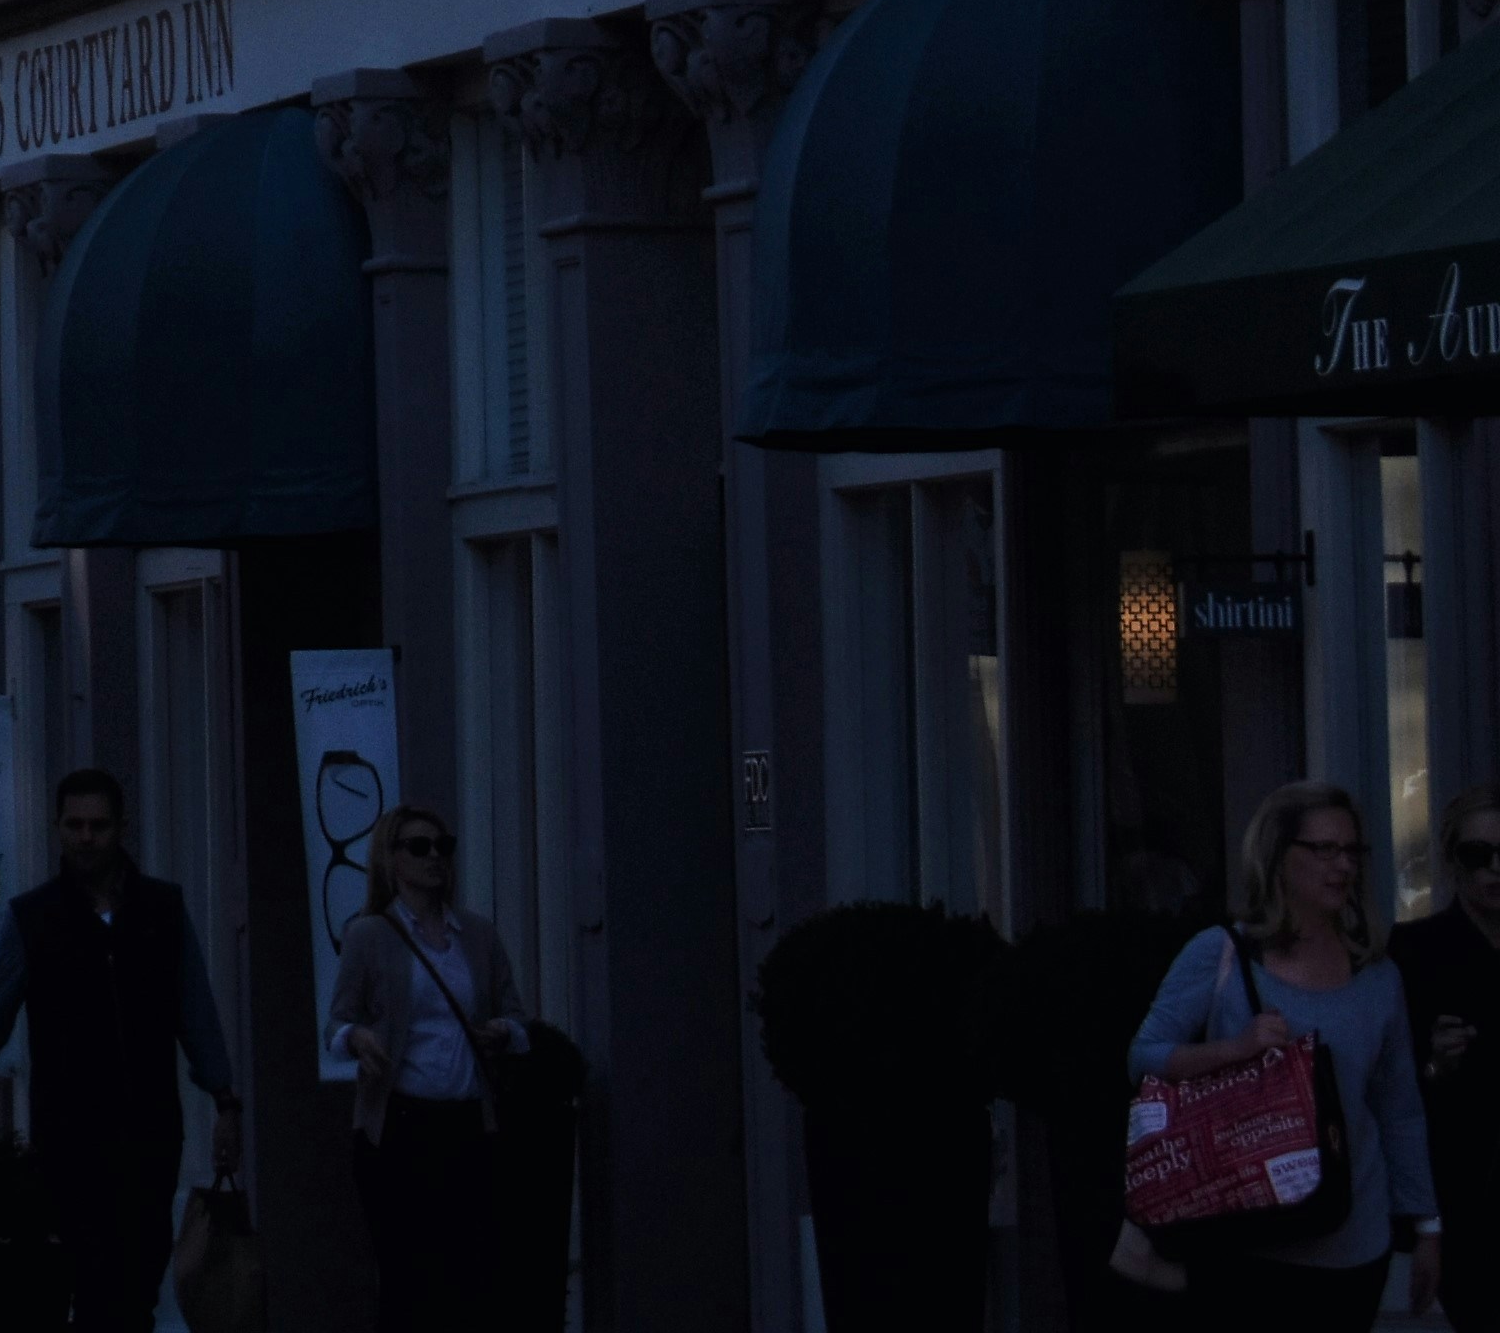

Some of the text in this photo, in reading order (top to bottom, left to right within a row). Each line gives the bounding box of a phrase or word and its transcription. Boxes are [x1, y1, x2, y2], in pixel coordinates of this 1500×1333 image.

[14, 9, 176, 152] COURTYARD
[1314, 275, 1390, 377] THE
[1194, 591, 1293, 629] shirtini
[300, 674, 387, 713] Friedrich's
[744, 757, 768, 803] FDC
